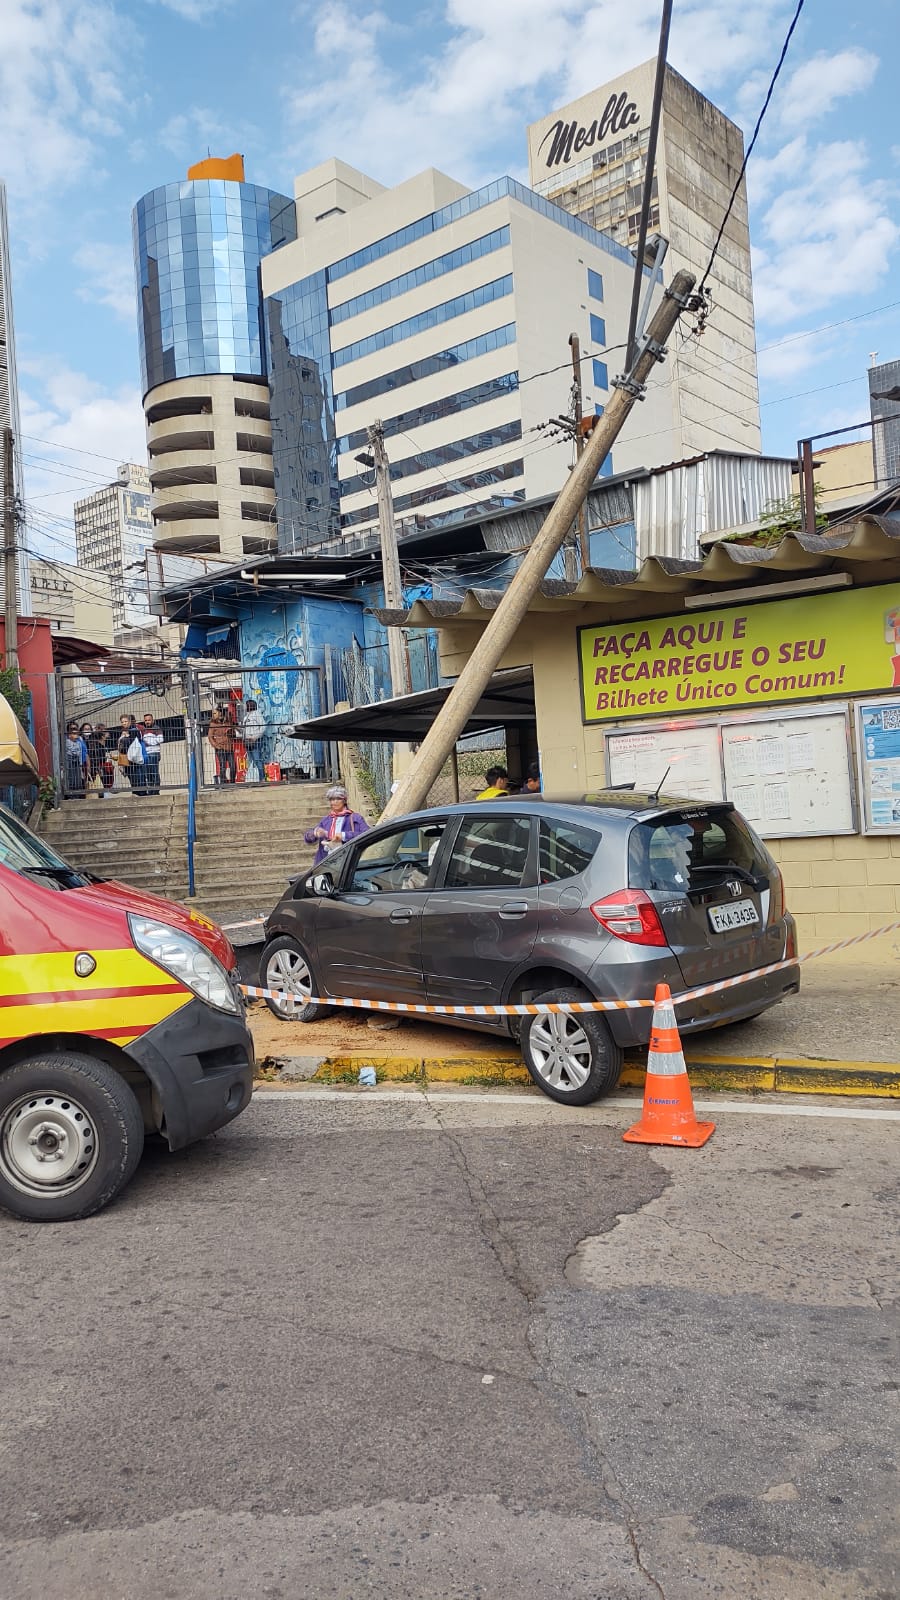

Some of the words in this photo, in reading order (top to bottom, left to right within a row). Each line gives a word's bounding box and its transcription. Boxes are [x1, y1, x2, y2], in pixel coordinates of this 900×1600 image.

[537, 91, 640, 168] Mesbla
[592, 632, 652, 660] FAÇA
[659, 620, 725, 650] AQUI
[732, 617, 748, 639] E
[594, 649, 744, 686] RECARREGUE
[751, 645, 771, 667] O
[778, 638, 827, 664] SEU
[596, 687, 669, 711] Bilhete
[676, 678, 738, 702] Único
[744, 665, 846, 694] Comum!
